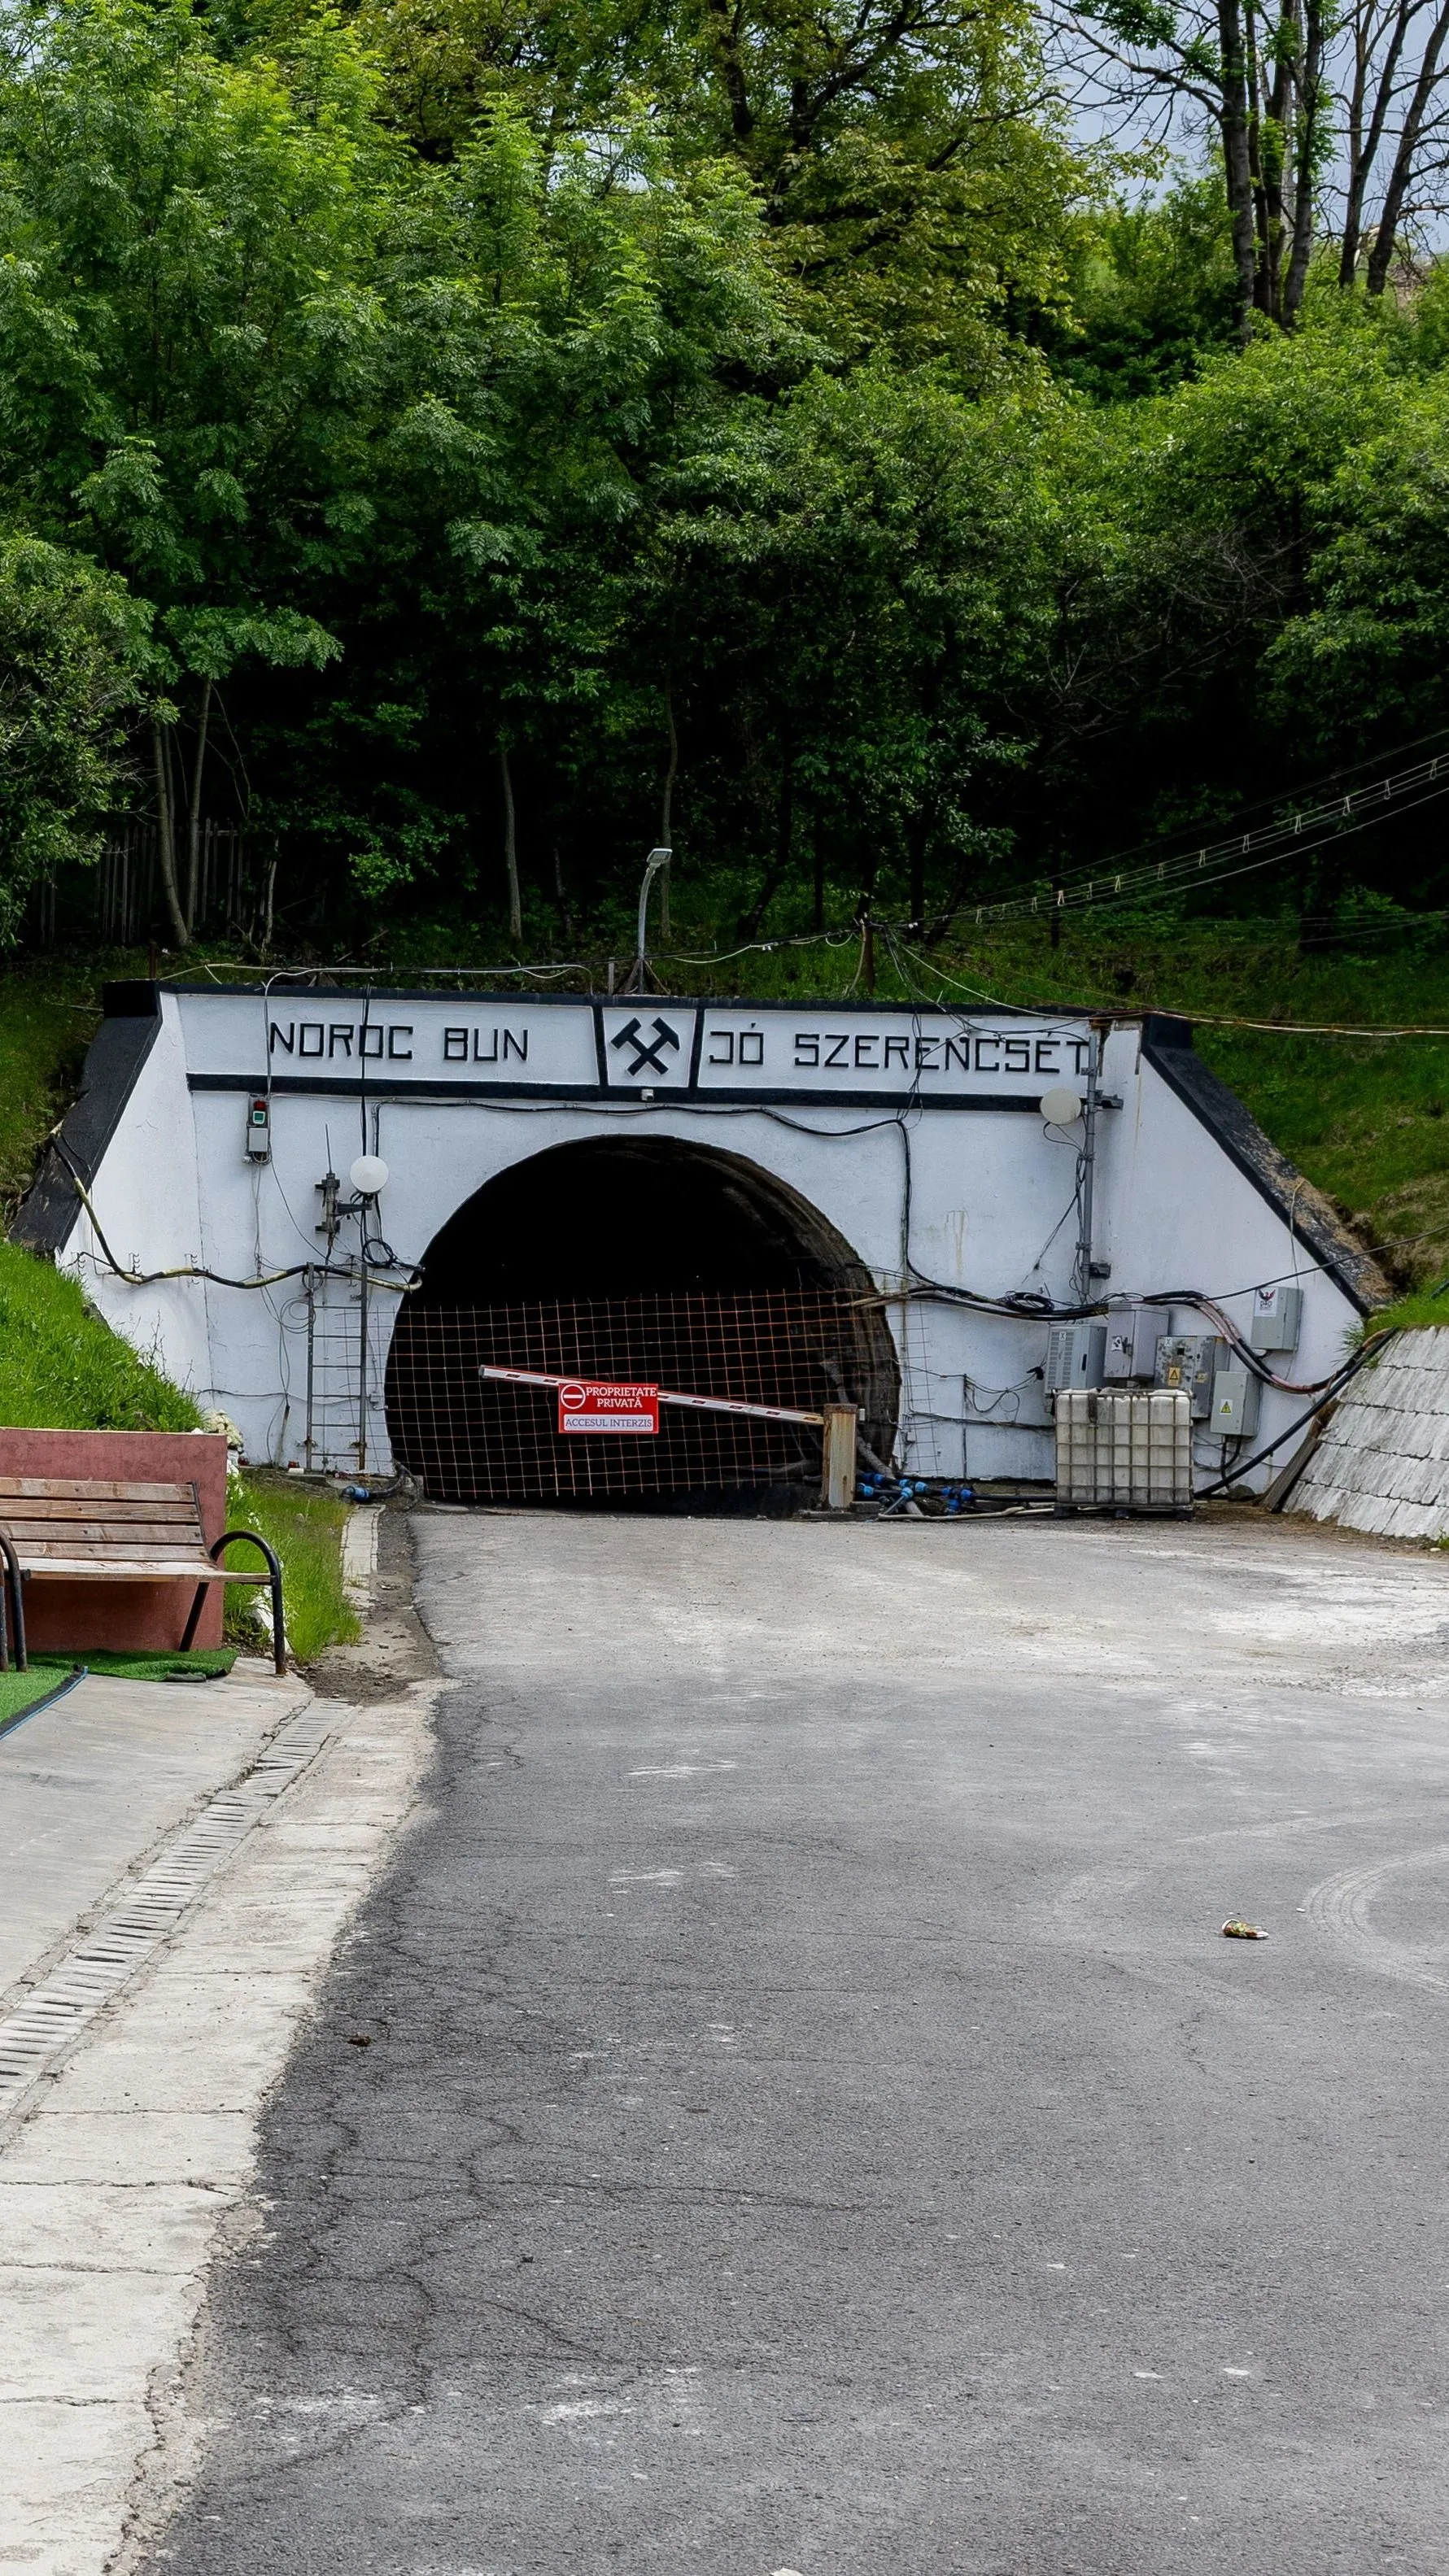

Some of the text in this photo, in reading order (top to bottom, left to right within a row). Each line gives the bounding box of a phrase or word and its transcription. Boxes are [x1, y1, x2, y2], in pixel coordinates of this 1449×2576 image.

[270, 1022, 529, 1061] NOROC BUN
[709, 1022, 764, 1065] JÓ
[586, 1387, 657, 1397] PROPRIETATE
[596, 1397, 643, 1408] PRIVATĂ
[565, 1419, 652, 1427] ACCESUL INTERZIS
